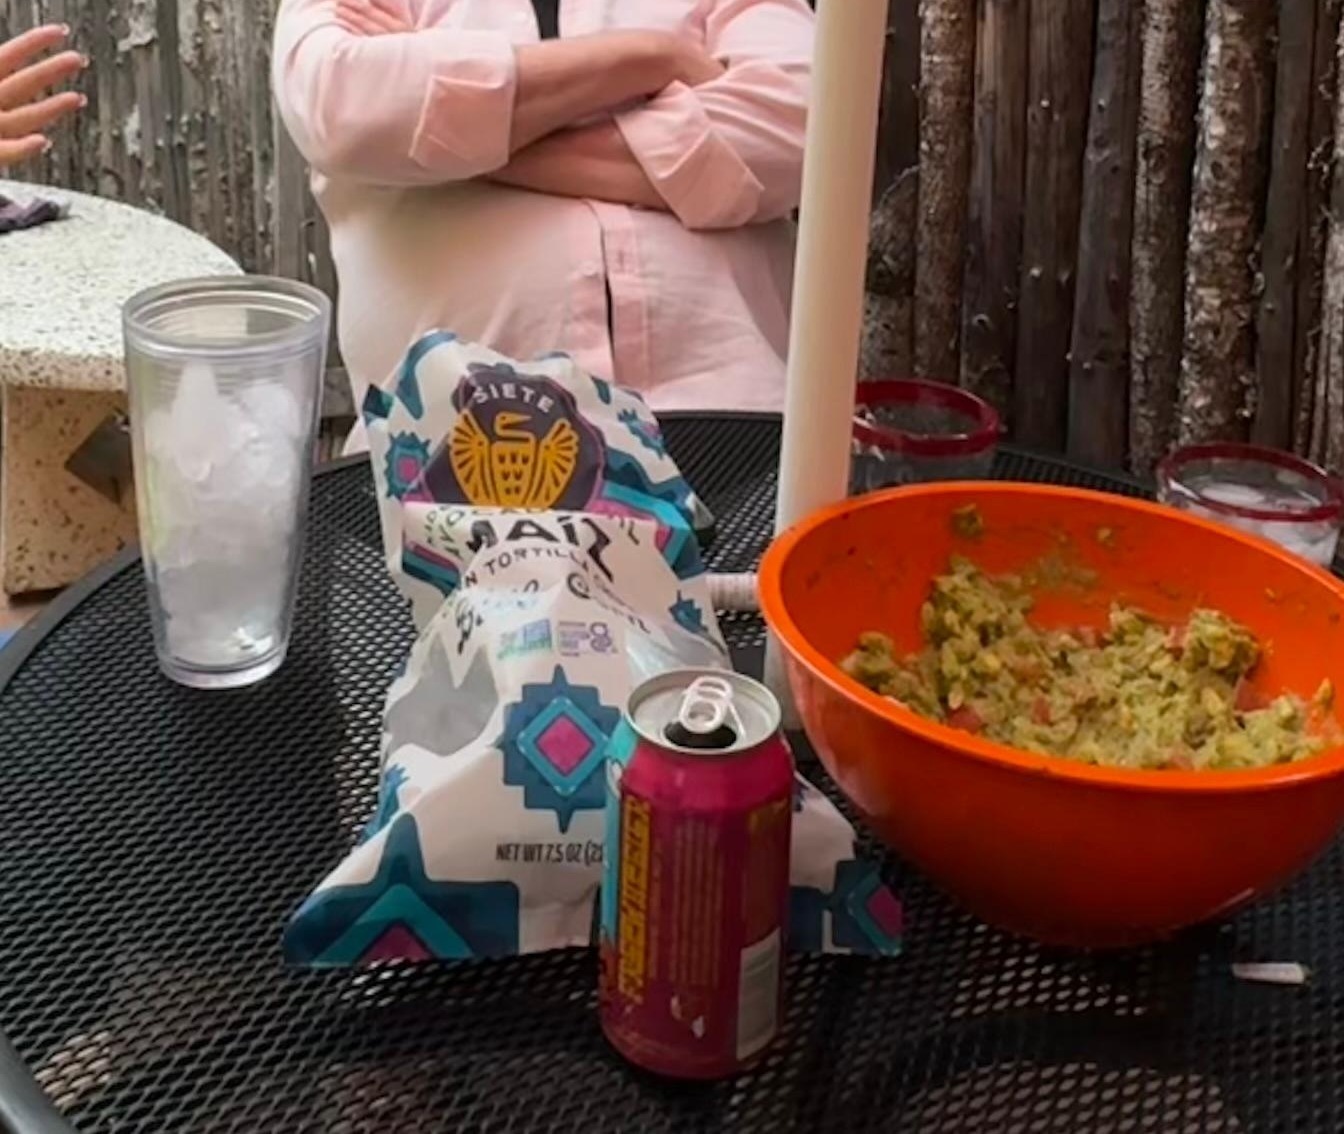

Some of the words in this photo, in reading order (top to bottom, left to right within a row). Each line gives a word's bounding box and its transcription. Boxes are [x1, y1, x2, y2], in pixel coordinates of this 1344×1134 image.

[473, 382, 555, 414] SIETE
[496, 843, 521, 862] NET
[523, 843, 544, 862] WT
[545, 843, 564, 863] 7.5
[565, 843, 582, 863] OZ
